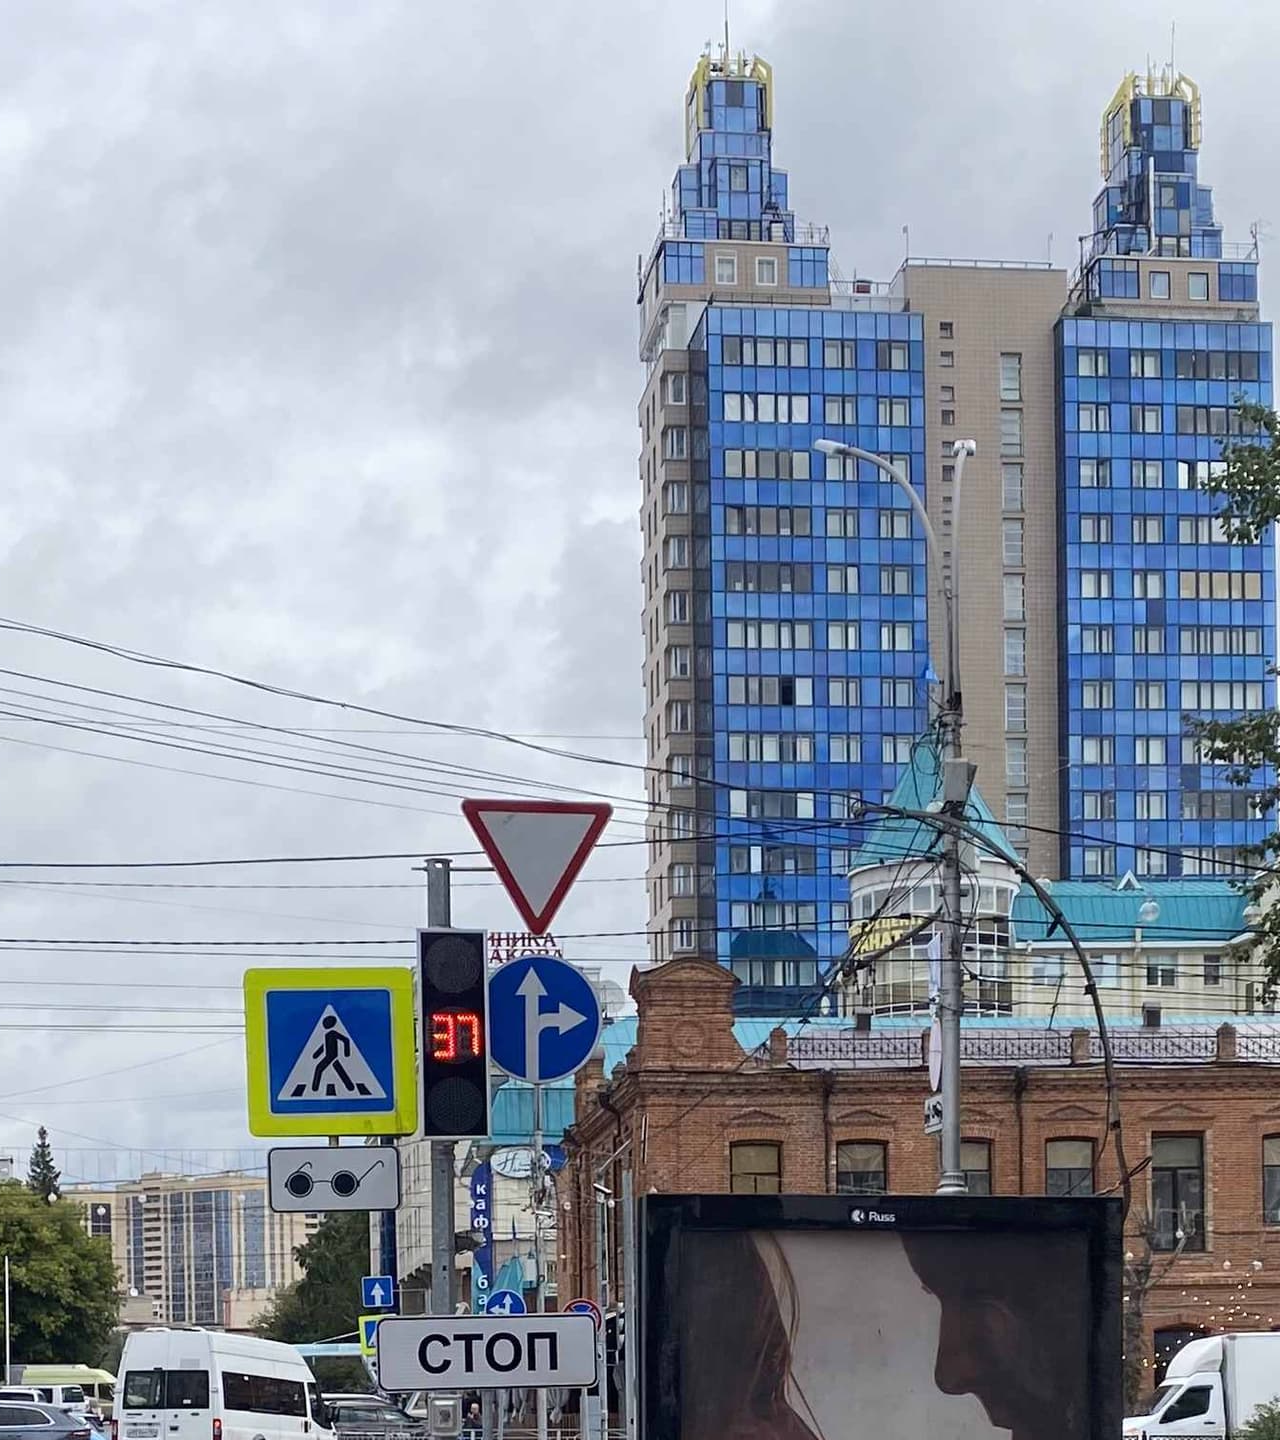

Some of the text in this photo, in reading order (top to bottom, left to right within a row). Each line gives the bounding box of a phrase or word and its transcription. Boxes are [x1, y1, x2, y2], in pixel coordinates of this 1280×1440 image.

[432, 1013, 479, 1057] 37
[868, 1211, 896, 1222] Russ
[418, 1332, 558, 1374] СТОП
